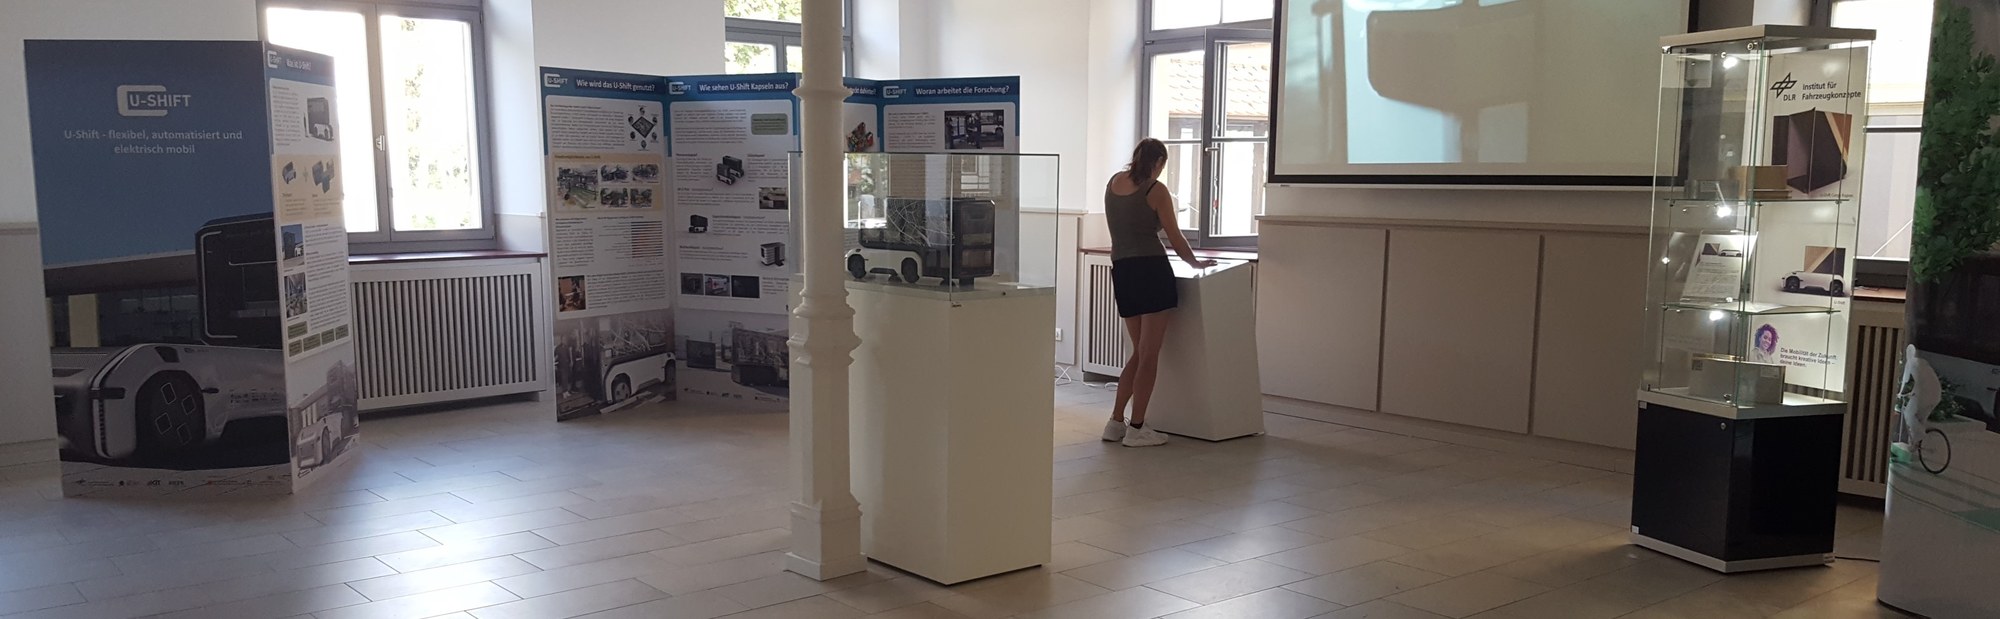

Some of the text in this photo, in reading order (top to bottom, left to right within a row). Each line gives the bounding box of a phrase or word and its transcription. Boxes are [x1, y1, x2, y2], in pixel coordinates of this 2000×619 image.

[576, 79, 655, 92] Wie wird das U-Shift genutzt?
[730, 83, 750, 91] U-Shift
[751, 82, 774, 91] Kapseln
[775, 81, 789, 89] aus?
[973, 86, 1009, 95] Forschung?
[1802, 81, 1837, 91] Institut für
[128, 94, 191, 107] U-SHIFT
[1802, 91, 1861, 101] Fahrzeugkonzepte
[64, 130, 99, 139] U-Shift
[108, 129, 149, 141] flexibel,
[151, 130, 220, 139] automatisiert
[223, 130, 243, 139] und
[114, 144, 195, 154] elektrisch mobil
